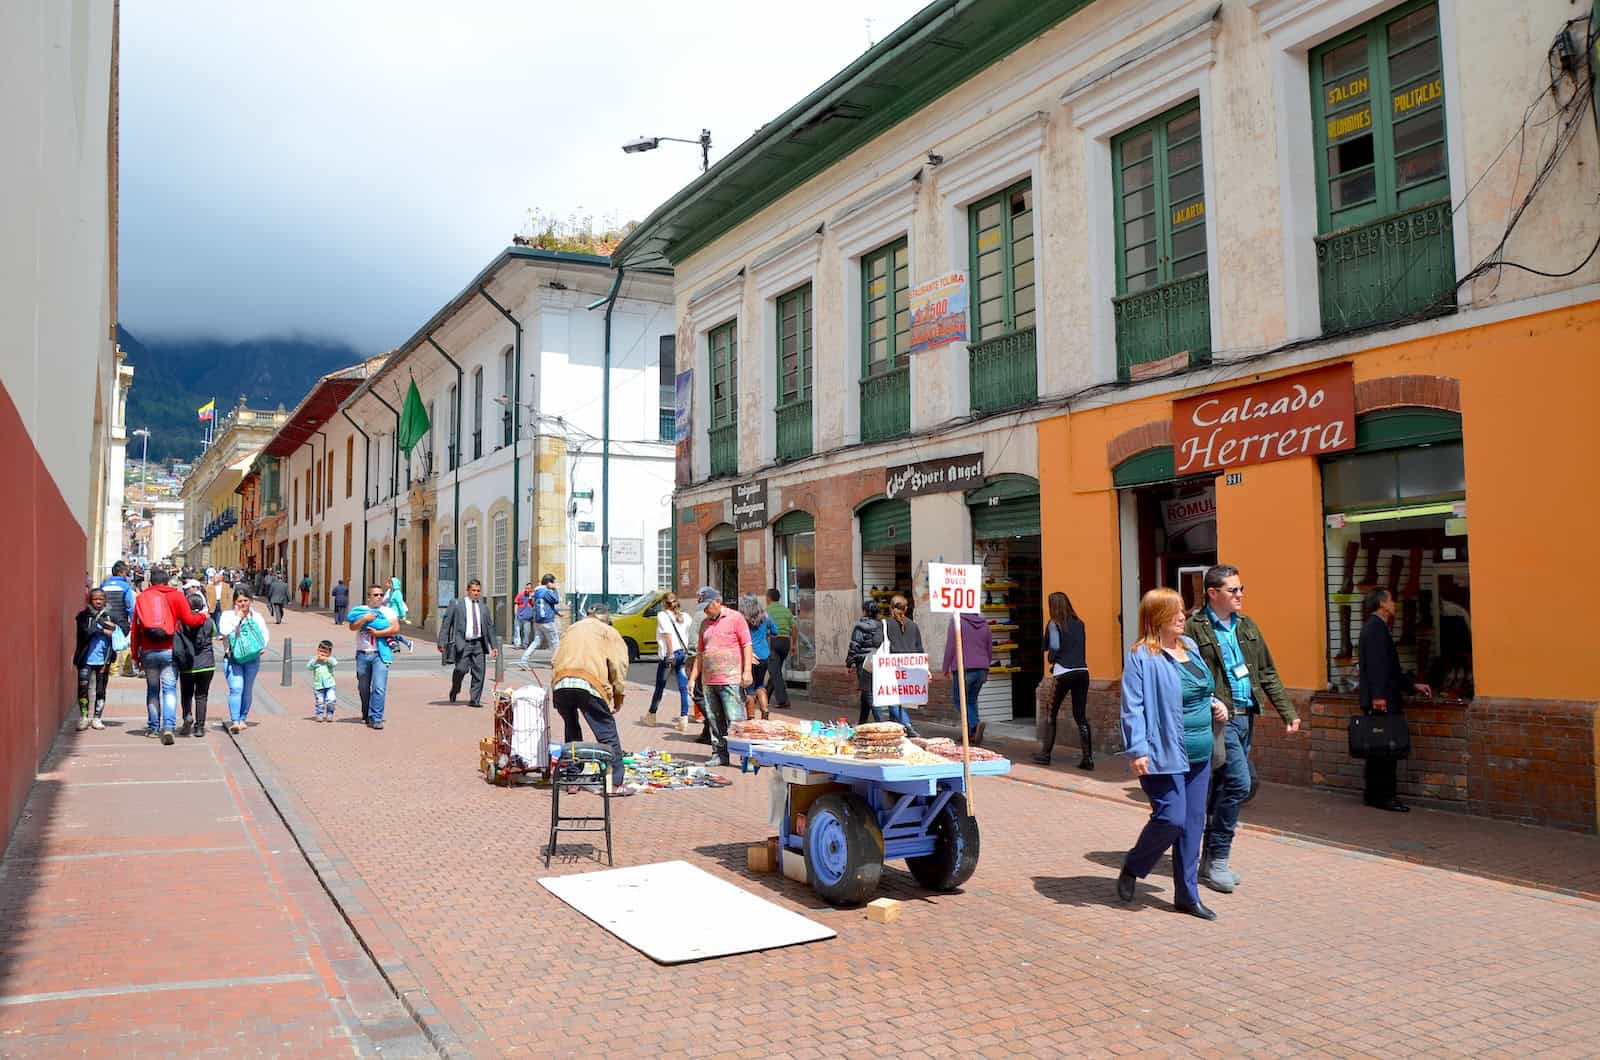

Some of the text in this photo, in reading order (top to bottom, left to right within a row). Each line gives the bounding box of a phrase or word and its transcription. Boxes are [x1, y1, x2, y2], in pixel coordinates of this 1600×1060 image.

[1328, 77, 1368, 105] SALON
[1394, 79, 1441, 113] POLITICAS
[1192, 384, 1325, 427] Calzado
[1178, 420, 1348, 471] Herrera
[911, 468, 945, 491] Sport
[948, 460, 981, 482] Angel
[944, 567, 967, 577] MANI
[944, 577, 967, 585] DULCE
[932, 587, 976, 609] A 500
[878, 655, 929, 668] PROMOCION
[895, 670, 908, 680] DE
[877, 684, 928, 696] ALMENDRA
